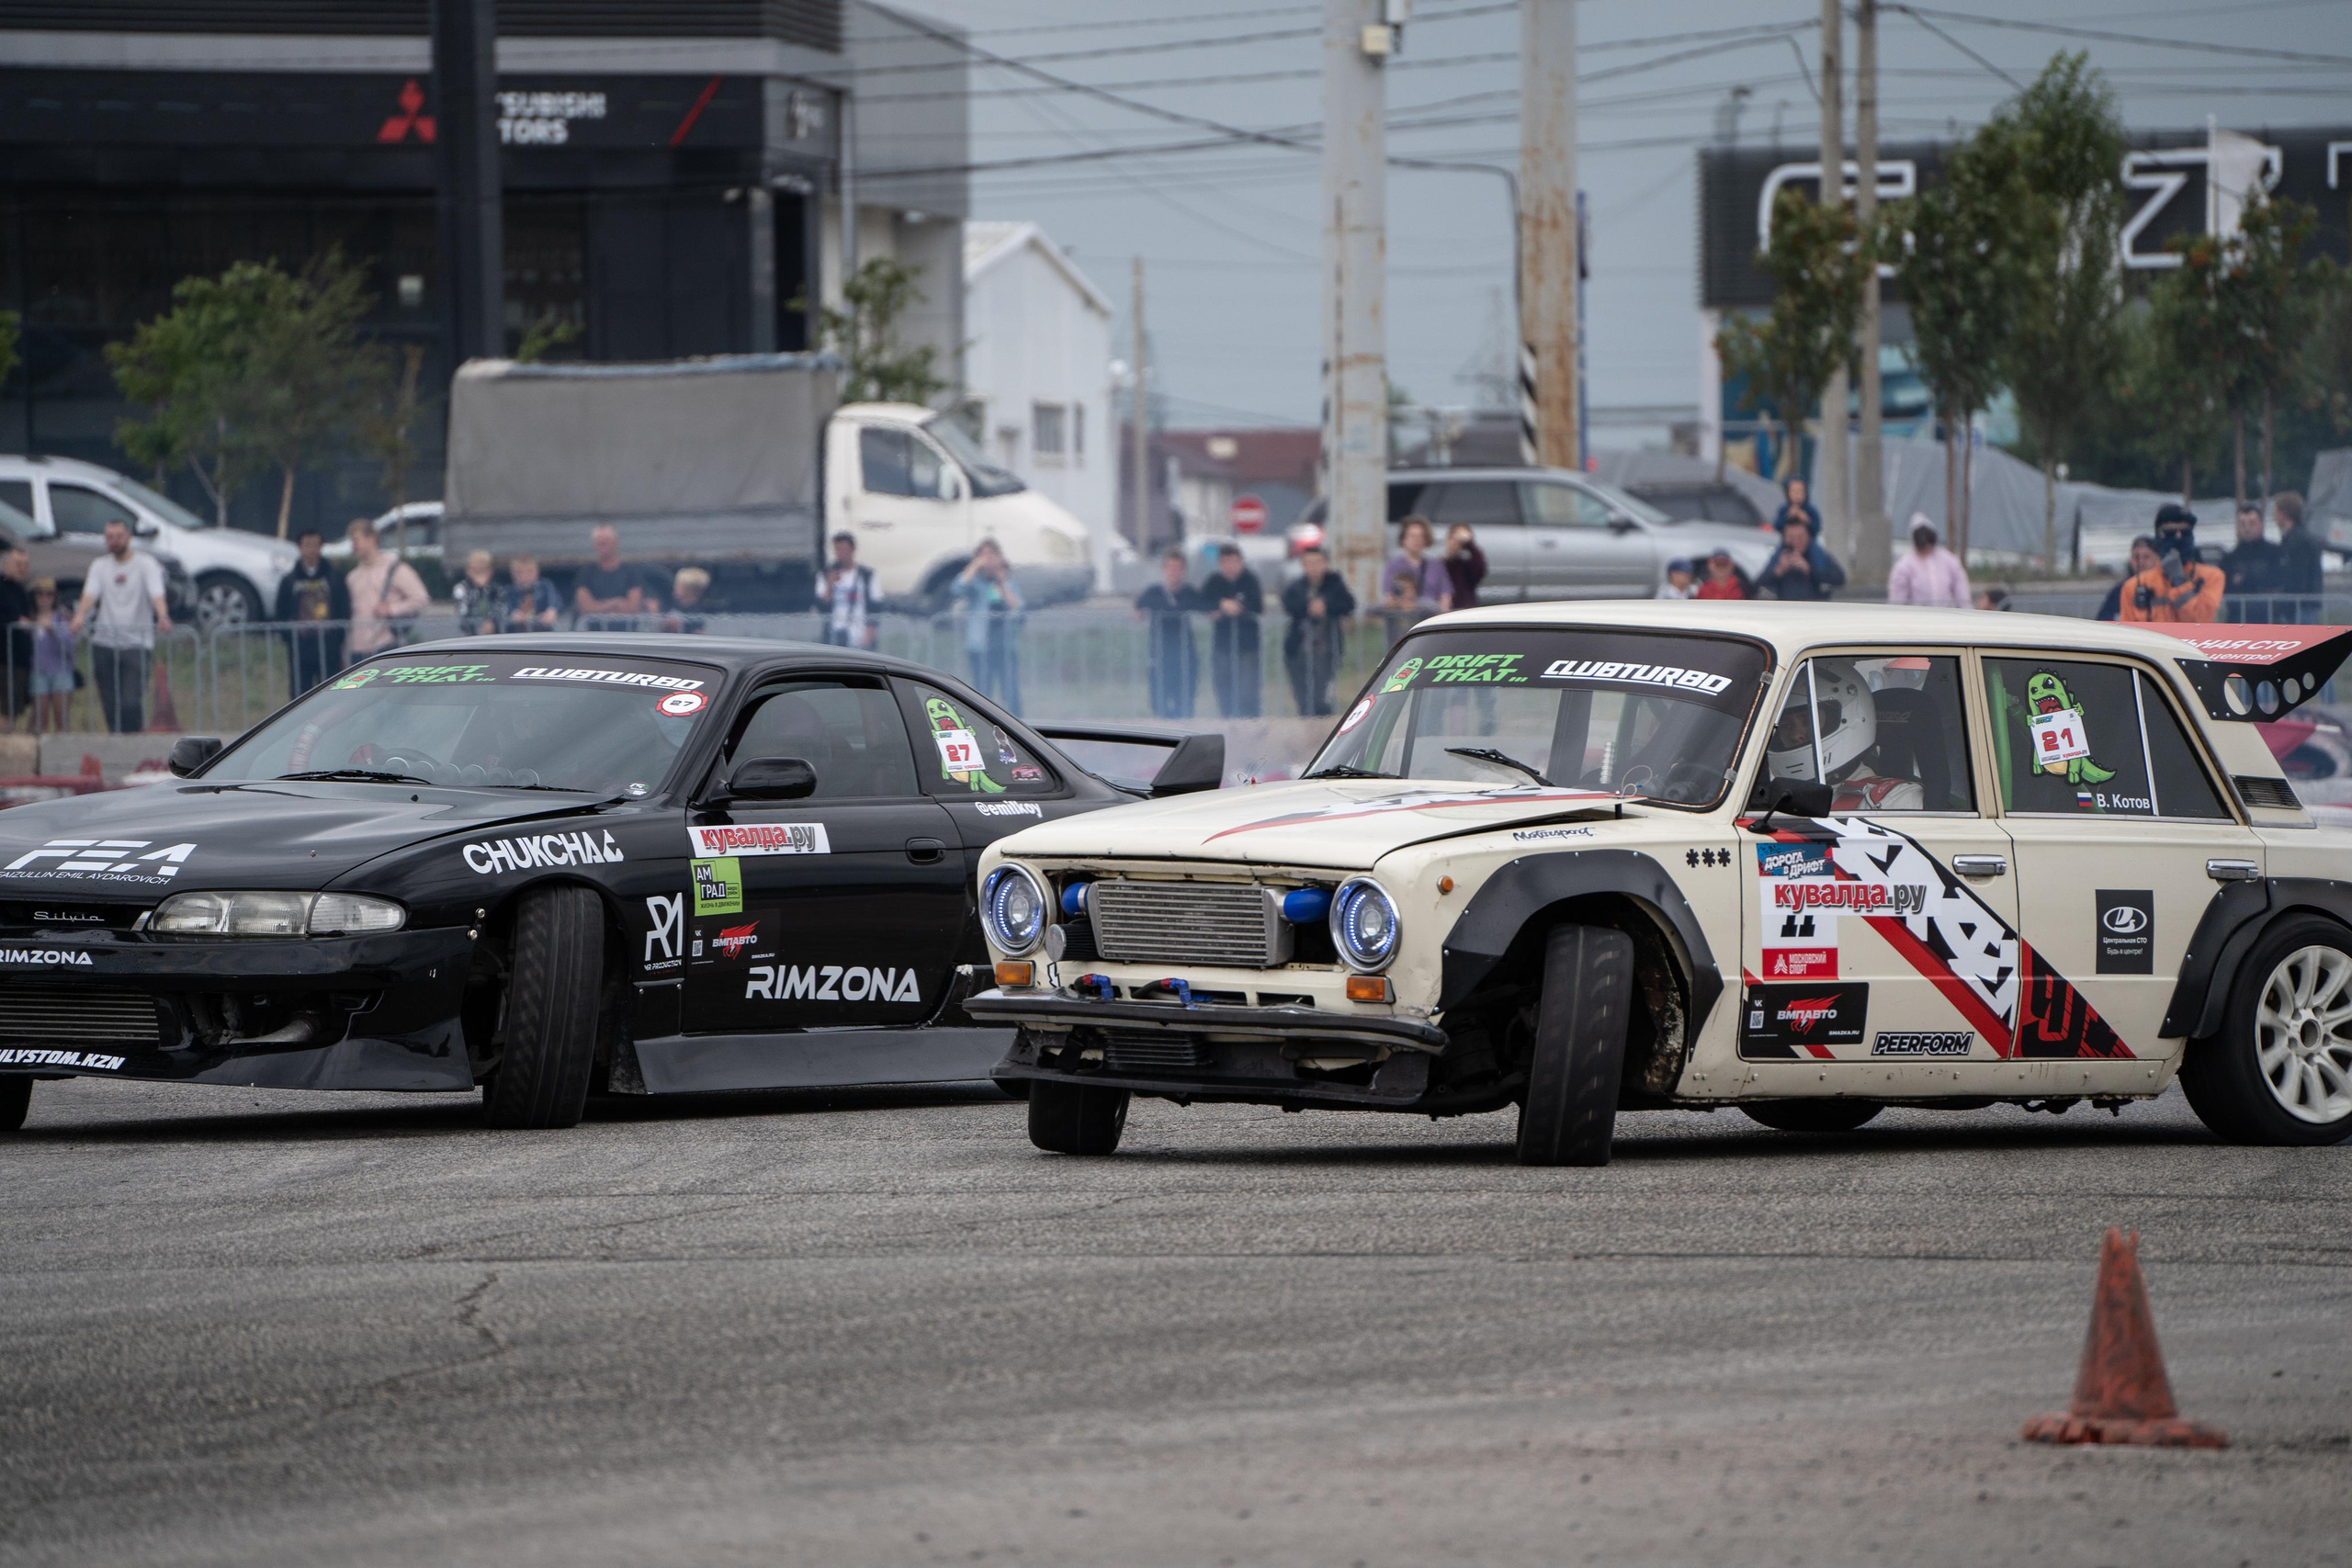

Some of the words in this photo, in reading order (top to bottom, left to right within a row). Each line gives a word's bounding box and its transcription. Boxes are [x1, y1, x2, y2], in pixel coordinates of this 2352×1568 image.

[496, 91, 607, 119] SUBISHI
[2247, 640, 2302, 650] СТО
[1424, 654, 1525, 670] DRIFT
[2208, 652, 2282, 660] центре!
[381, 664, 491, 676] DRIFT
[390, 672, 496, 683] THAT...
[1431, 668, 1529, 682] THAT...
[1540, 660, 1733, 695] CLUBTURBO
[510, 667, 705, 692] CLUBTURBO
[2041, 728, 2075, 752] 21
[945, 744, 970, 761] 27
[2097, 793, 2110, 808] В.
[2112, 794, 2151, 809] Котов
[699, 826, 815, 855] кувалда.ру
[1763, 851, 1805, 872] ДОРОГА
[1789, 859, 1827, 879] ДРИФТ
[56, 872, 85, 880] EMIL
[85, 874, 172, 886] AYDAROVICH
[696, 866, 712, 881] АМ
[700, 883, 726, 899] ГРАД
[1774, 883, 1926, 915] кувалда.ру
[33, 911, 105, 922] Silvia
[712, 935, 757, 948] ВМПАВТО
[745, 964, 921, 1002] RIMZONA
[1777, 1009, 1838, 1021] ВМПАВТО
[1871, 1032, 1974, 1055] PEERFORM
